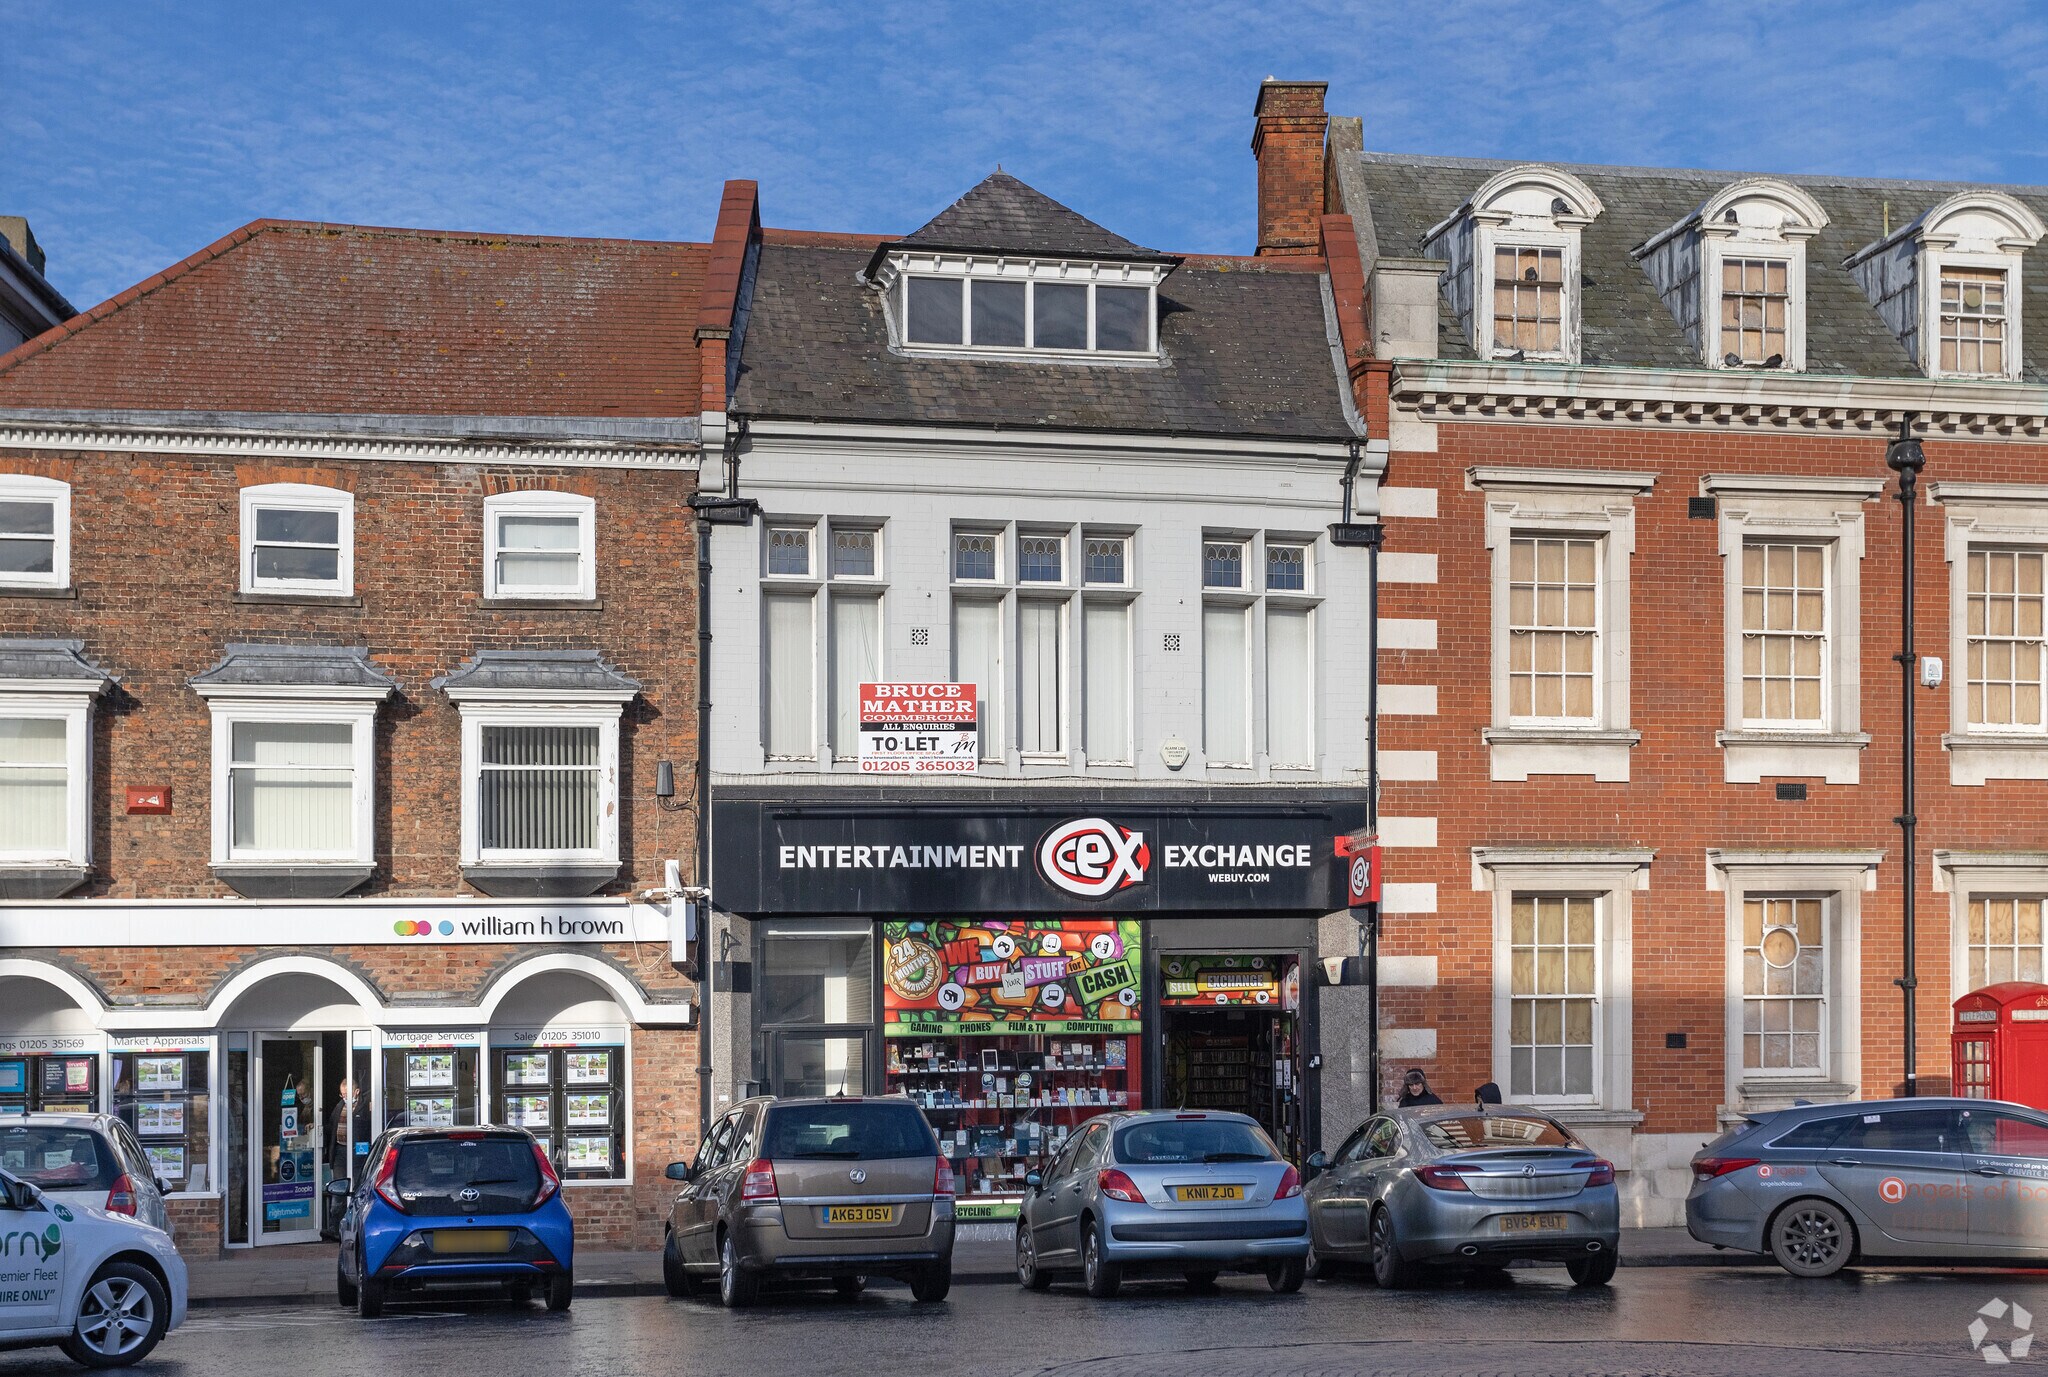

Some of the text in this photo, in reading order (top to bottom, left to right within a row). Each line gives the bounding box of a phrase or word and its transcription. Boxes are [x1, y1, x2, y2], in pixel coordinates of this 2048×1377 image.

[875, 685, 961, 698] BRUCE
[863, 700, 974, 713] MATHER
[903, 723, 955, 731] ENQUIRIES
[872, 737, 939, 751] TO LET
[862, 761, 975, 771] 01205 365032
[779, 844, 1311, 868] ENTERTAINMENT EXCHANGE
[1208, 873, 1270, 883] WEBUY.COM
[461, 915, 624, 936] william h brown
[893, 940, 916, 964] 24
[944, 938, 980, 966] WE
[894, 953, 931, 980] MONTHS
[904, 966, 935, 991] WARRANTY
[976, 965, 1001, 981] BUY
[1025, 960, 1064, 981] STUFF
[1069, 960, 1082, 972] for
[1083, 965, 1129, 995] CASH
[1170, 974, 1264, 993] SELL EXCHANGE
[910, 1021, 1114, 1034] GAMING PHONES FILM & TV COMPUTING
[114, 1035, 205, 1047] Market Appraisals
[387, 1032, 475, 1043] Mortgage Services
[514, 1030, 601, 1041] Sales 01205 351010
[19, 1039, 48, 1050] 01205
[52, 1038, 85, 1049] 351569
[1990, 1160, 2014, 1168] discount
[2008, 1167, 2042, 1177] PRIVATE
[294, 1185, 313, 1194] Zoopla
[1186, 1187, 1235, 1199] KN11 ZJO
[1878, 1176, 1975, 1204] angels
[1984, 1179, 2010, 1201] of
[268, 1206, 302, 1219] rightmove
[831, 1208, 889, 1221] AK63 OSV
[955, 1207, 992, 1217] CYCLING
[1506, 1216, 1537, 1230] BV64
[0, 1231, 40, 1257] rn
[0, 1268, 58, 1282] emier Fleet
